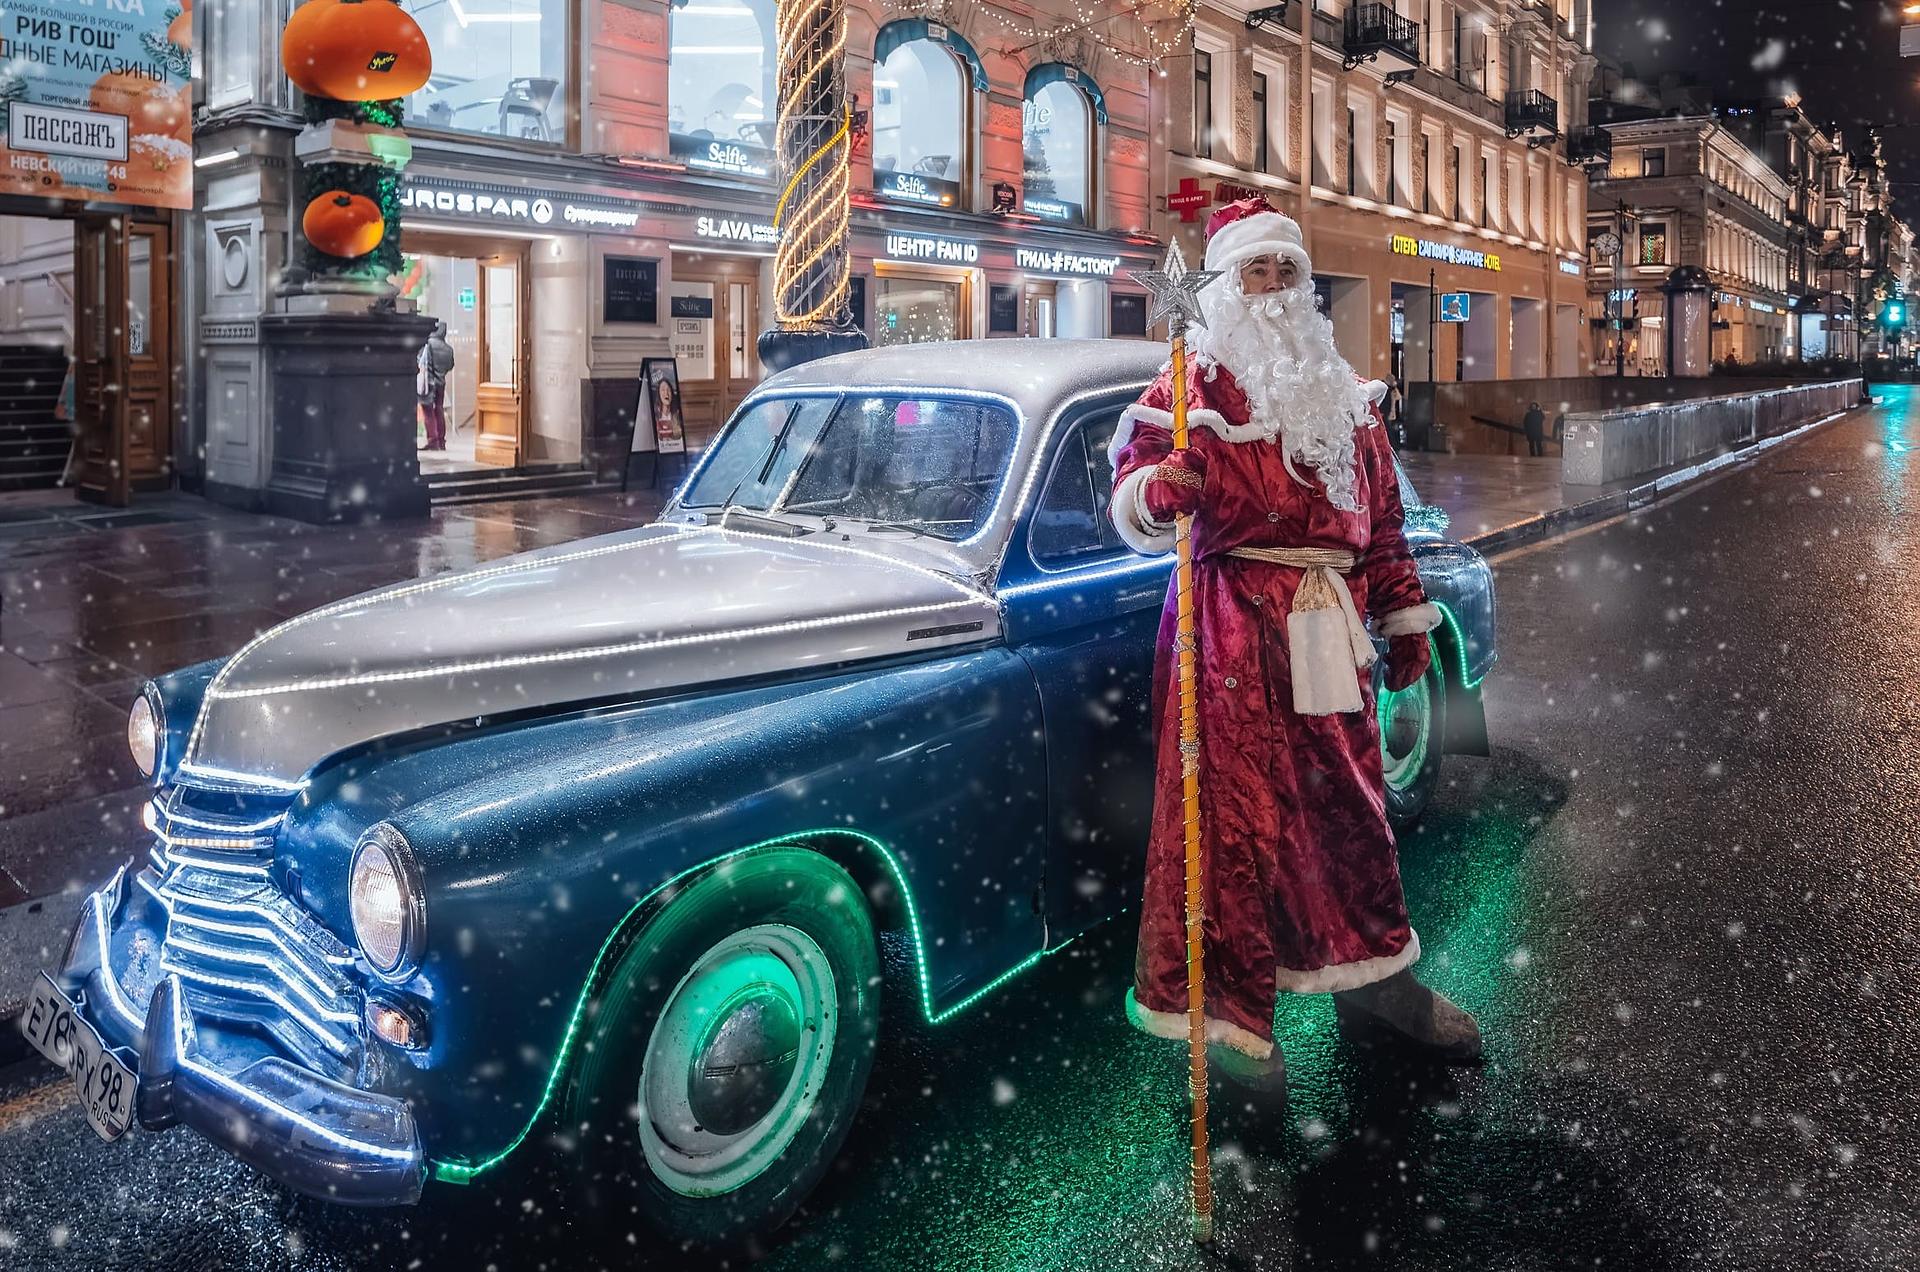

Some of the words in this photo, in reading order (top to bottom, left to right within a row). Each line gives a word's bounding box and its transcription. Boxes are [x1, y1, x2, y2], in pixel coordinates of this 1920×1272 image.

[1, 3, 38, 14] САМЫЙ
[40, 8, 88, 23] БОЛЬШОЙ
[90, 17, 96, 25] В
[98, 18, 134, 32] РОССИИ
[17, 15, 62, 41] РИВ
[64, 49, 168, 85] МАГАЗИНЫ
[41, 92, 81, 106] ТОРГОВЫЙ
[10, 155, 76, 175] НЕВСКИЙ
[109, 166, 127, 179] 48
[708, 143, 748, 166] Selfie
[896, 175, 926, 195] Selfie
[697, 217, 753, 241] SLAVA
[887, 235, 935, 258] ЦЕНТР
[936, 240, 962, 261] FAN
[964, 244, 978, 262] ID
[1393, 235, 1418, 256] ОТЕЛЬ
[1484, 253, 1502, 272] HOTEL
[99, 1062, 123, 1114] 98
[91, 1101, 109, 1126] RUS
